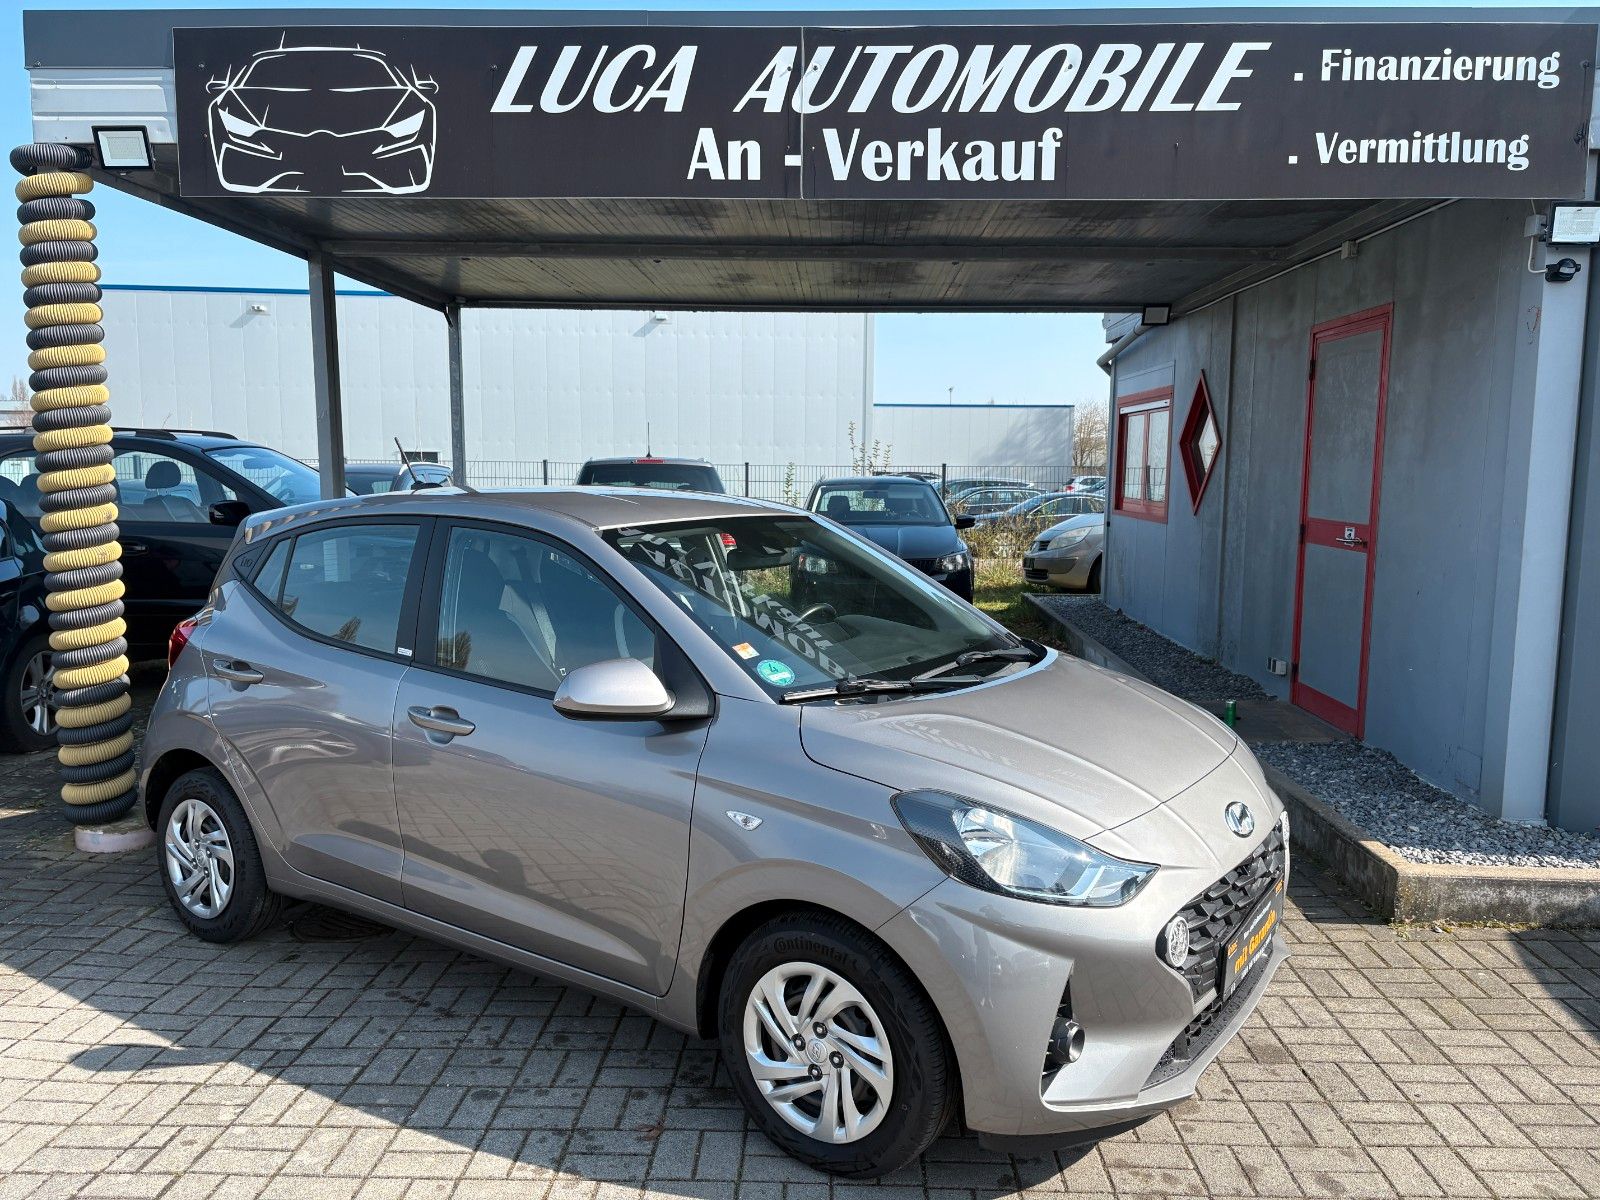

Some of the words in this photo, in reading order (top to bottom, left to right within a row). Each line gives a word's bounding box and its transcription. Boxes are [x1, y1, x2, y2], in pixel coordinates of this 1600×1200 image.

[490, 44, 698, 114] LUCA
[732, 42, 1272, 114] AUTOMOBILE
[1321, 47, 1561, 90] Finanzierung
[686, 127, 761, 181] An
[822, 127, 1064, 182] Verkauf
[1315, 130, 1530, 171] Vermittlung
[773, 936, 849, 966] Continental
